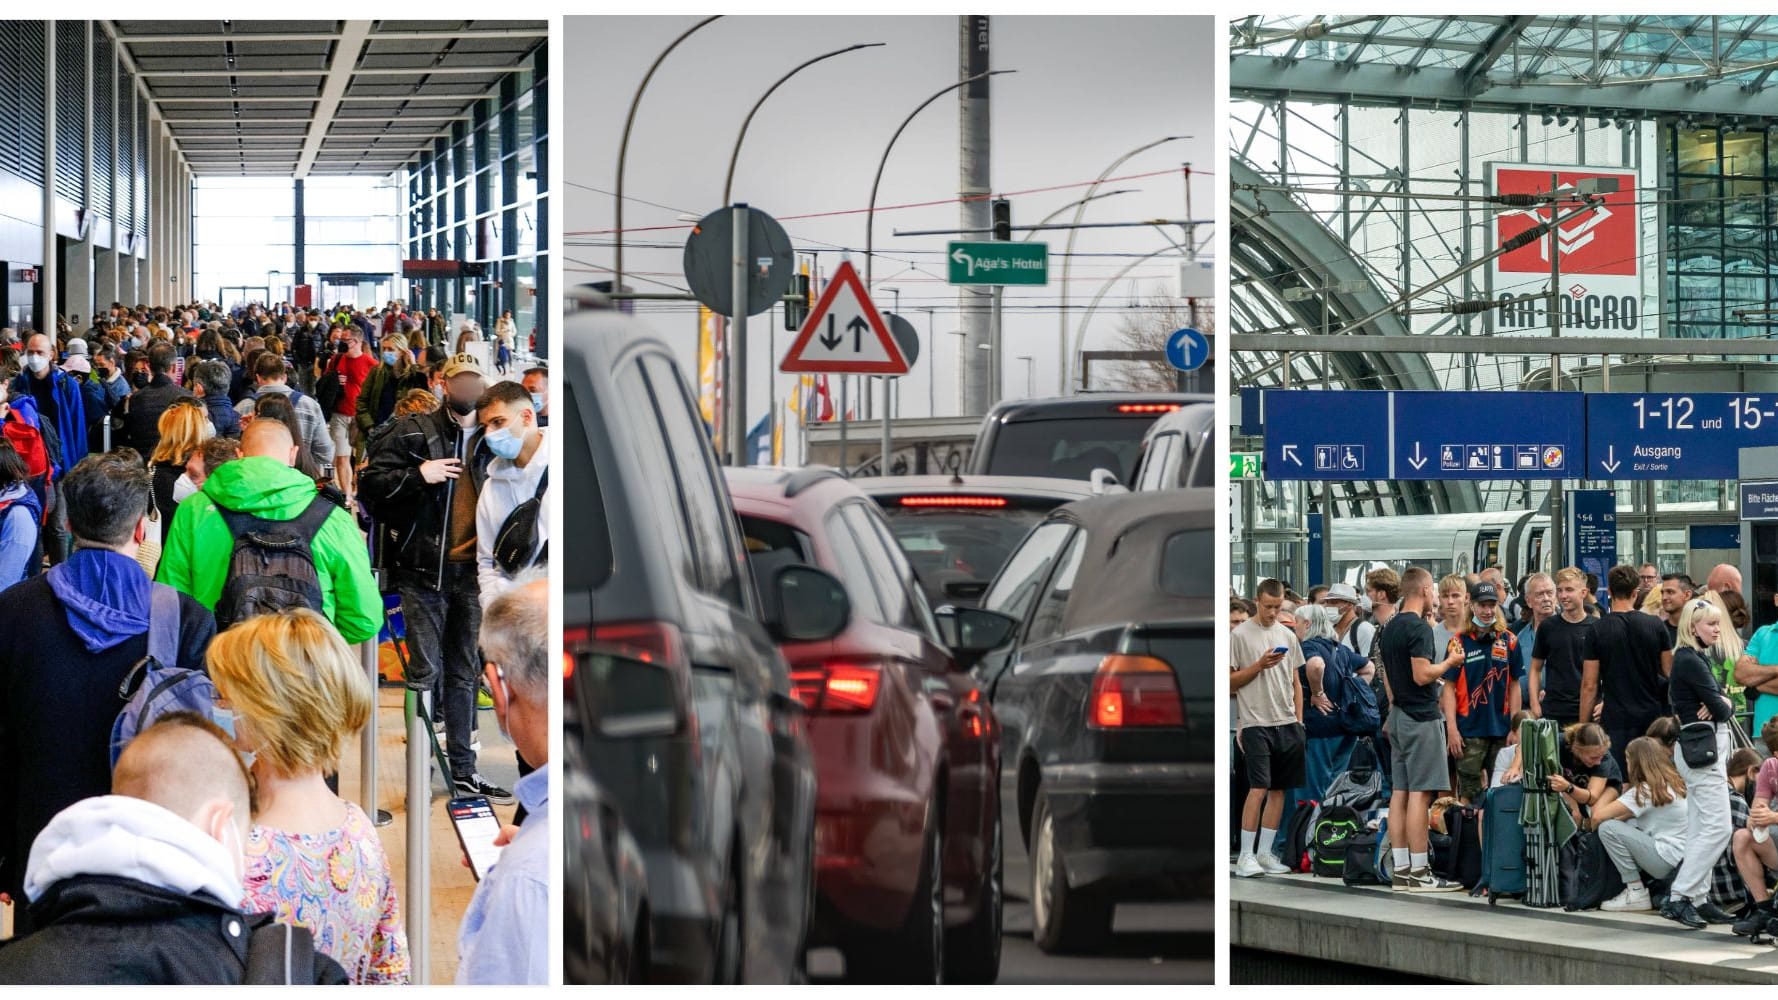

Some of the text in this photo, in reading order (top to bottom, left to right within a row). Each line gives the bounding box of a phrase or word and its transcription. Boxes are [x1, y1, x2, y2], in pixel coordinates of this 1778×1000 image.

[1012, 257, 1043, 269] Hotel
[1633, 397, 1778, 429] 1-12 und 15-
[1633, 445, 1681, 459] Ausgang
[1633, 463, 1646, 471] Exit
[1650, 463, 1668, 471] Sortie
